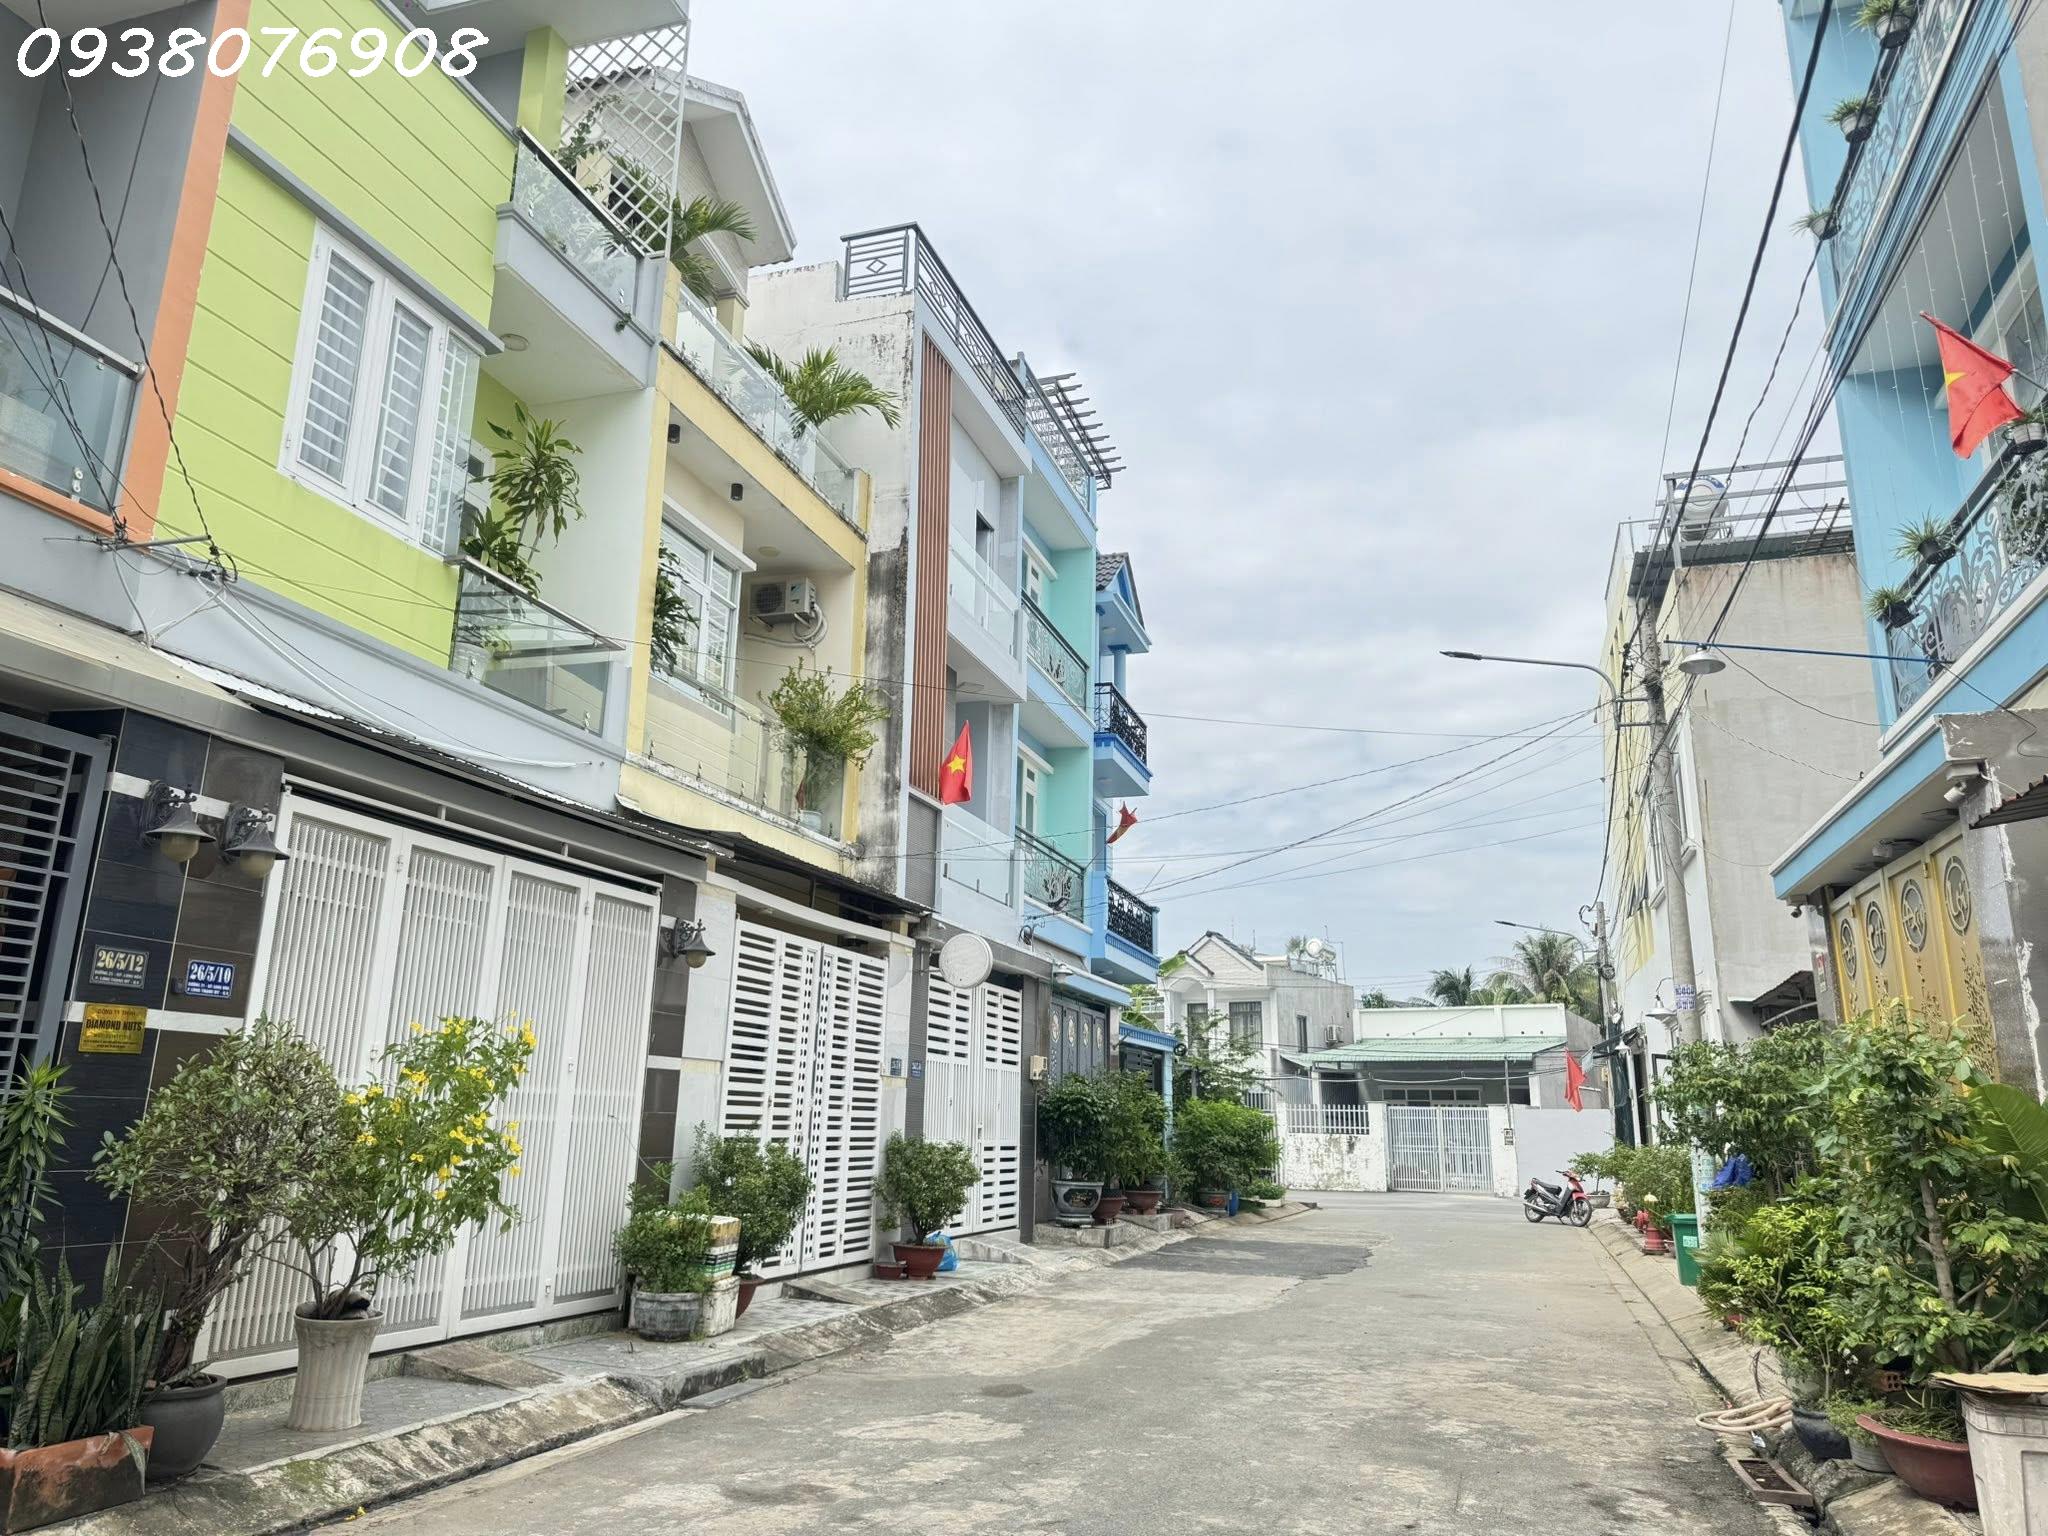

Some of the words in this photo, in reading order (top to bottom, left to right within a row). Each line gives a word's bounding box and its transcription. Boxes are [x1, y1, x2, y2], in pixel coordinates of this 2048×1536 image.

[96, 950, 144, 972] 26/5/12
[190, 963, 231, 984] 26/5/10
[86, 1018, 121, 1030] DIAMOND
[123, 1021, 142, 1031] NUTS
